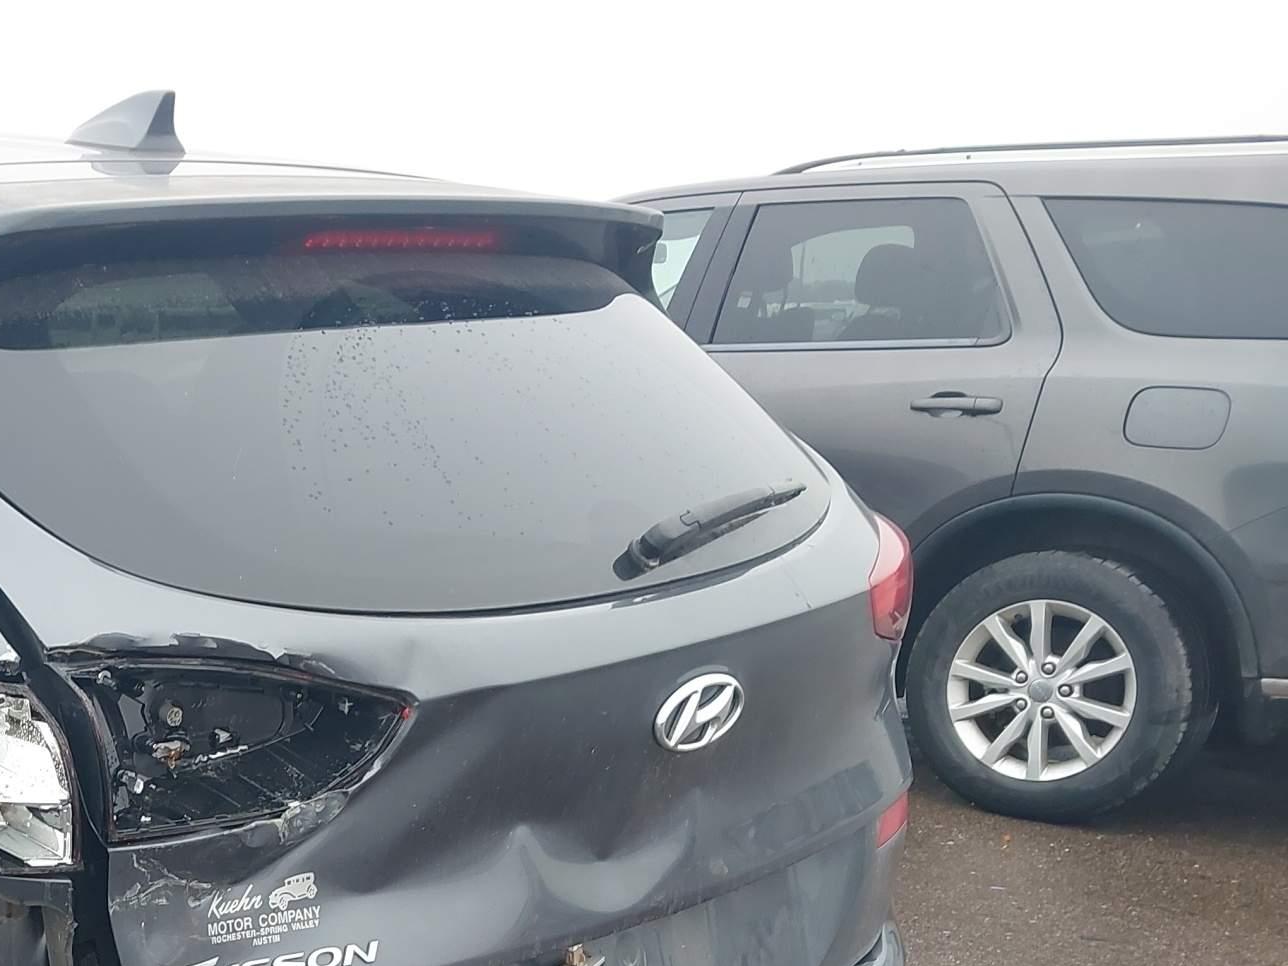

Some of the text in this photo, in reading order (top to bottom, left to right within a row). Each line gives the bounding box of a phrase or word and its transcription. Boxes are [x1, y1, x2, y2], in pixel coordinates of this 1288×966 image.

[208, 884, 263, 919] Kuehn
[208, 905, 320, 936] MOTOR COMPANY
[291, 918, 319, 931] VALLEY
[252, 934, 280, 946] AUSTIN
